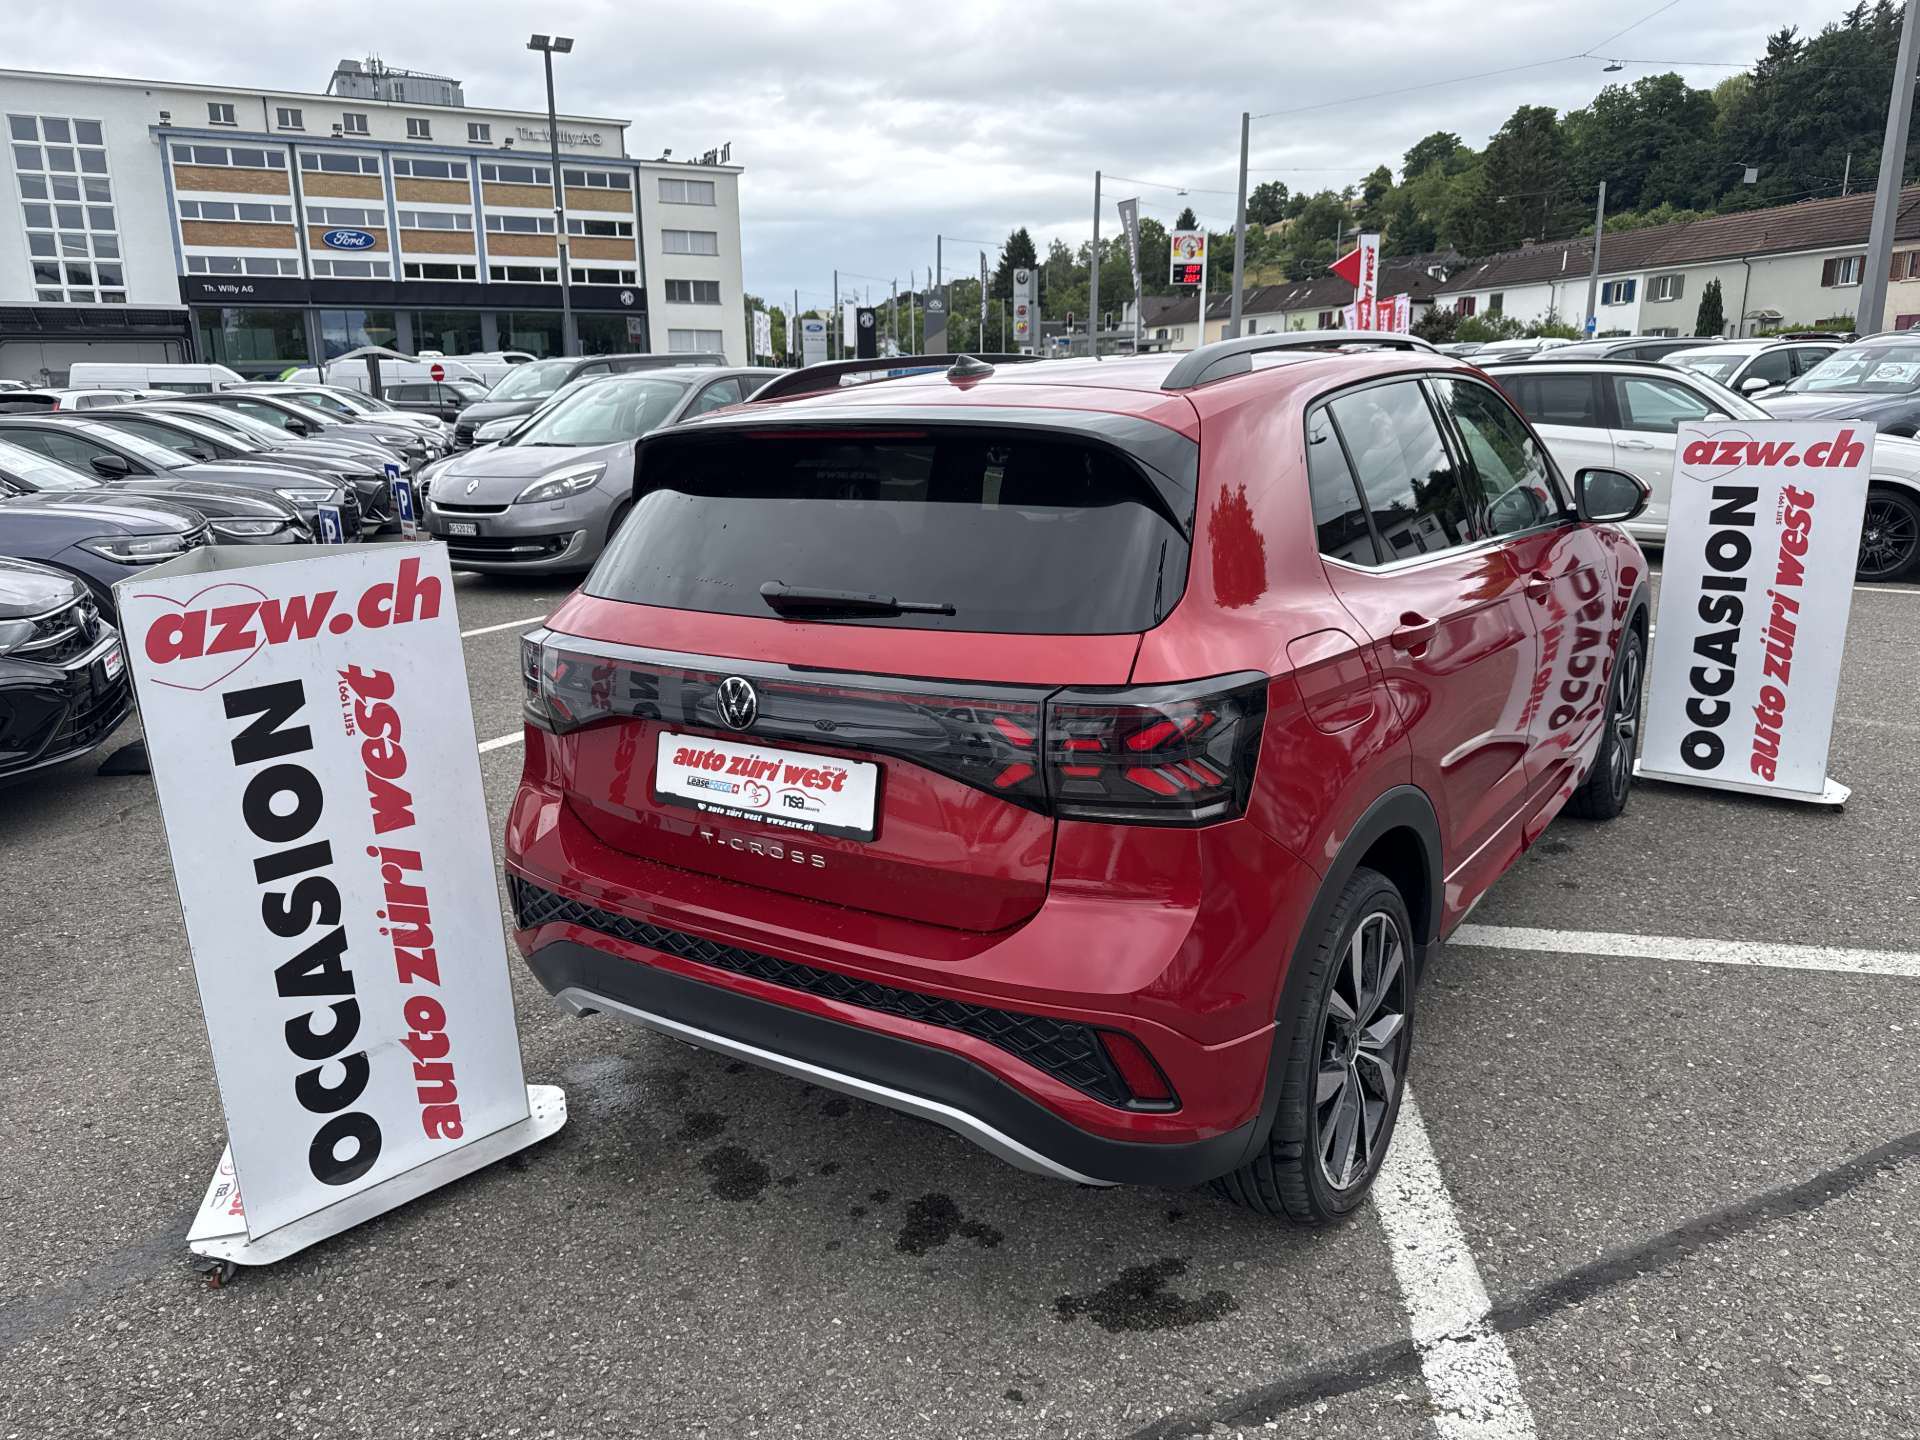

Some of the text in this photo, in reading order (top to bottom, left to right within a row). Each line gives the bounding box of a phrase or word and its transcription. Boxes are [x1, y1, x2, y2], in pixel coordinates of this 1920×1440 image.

[202, 284, 254, 295] Th. Willy AG
[860, 312, 874, 328] MG
[1682, 429, 1865, 468] azw.ch
[399, 489, 408, 515] P
[325, 518, 337, 544] P
[144, 557, 442, 665] azw.ch
[1680, 485, 1759, 771] OCCASION
[1750, 484, 1815, 782] auto züri west
[338, 680, 356, 736] SEIT 1991
[673, 747, 848, 792] auto züri west
[708, 804, 724, 814] auto
[744, 811, 762, 822] west
[783, 794, 805, 810] nsa
[701, 831, 826, 868] T-CROSS
[337, 664, 464, 1140] auto züri west
[222, 678, 383, 1186] OCCASION
